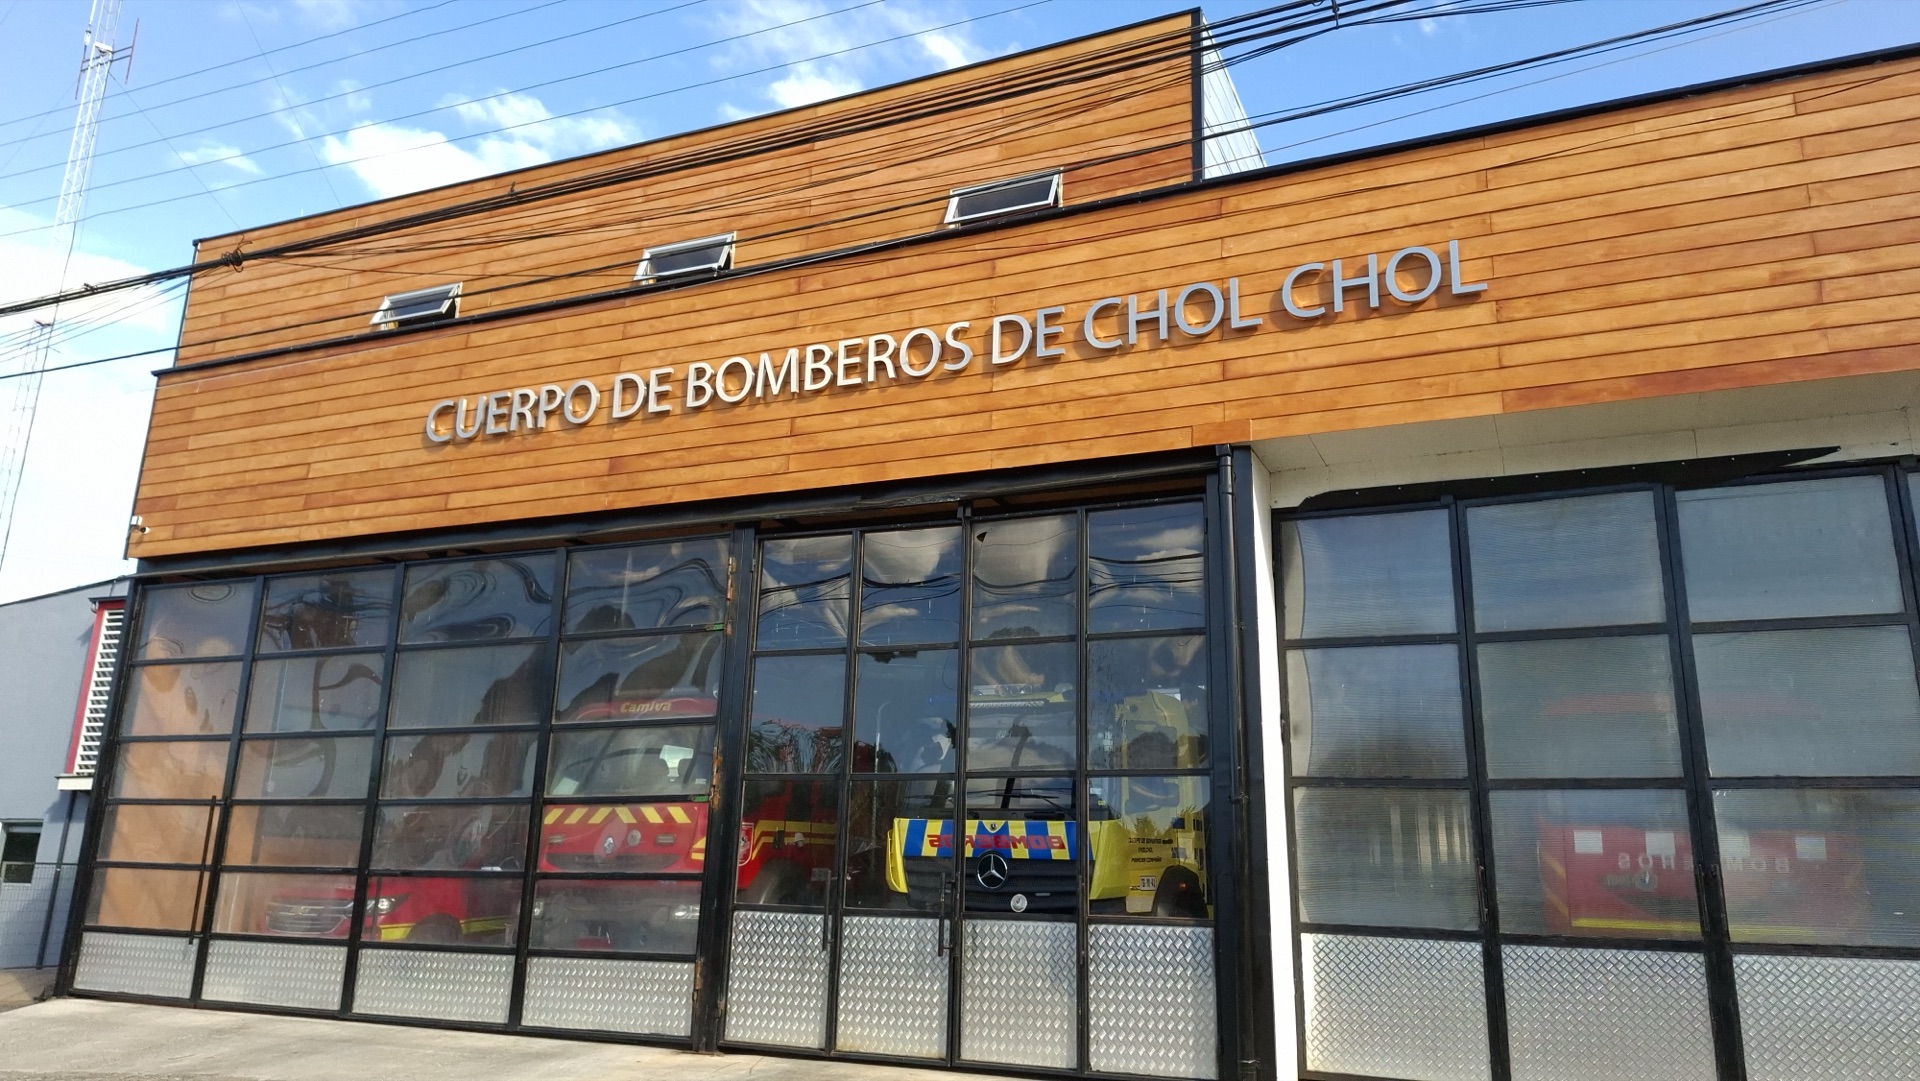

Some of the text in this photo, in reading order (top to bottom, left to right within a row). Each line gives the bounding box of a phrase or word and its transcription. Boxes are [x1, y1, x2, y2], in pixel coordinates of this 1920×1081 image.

[425, 239, 1488, 443] CUERPO DE BOMBEROS DE CHOL CHOL
[620, 701, 672, 713] Camiva
